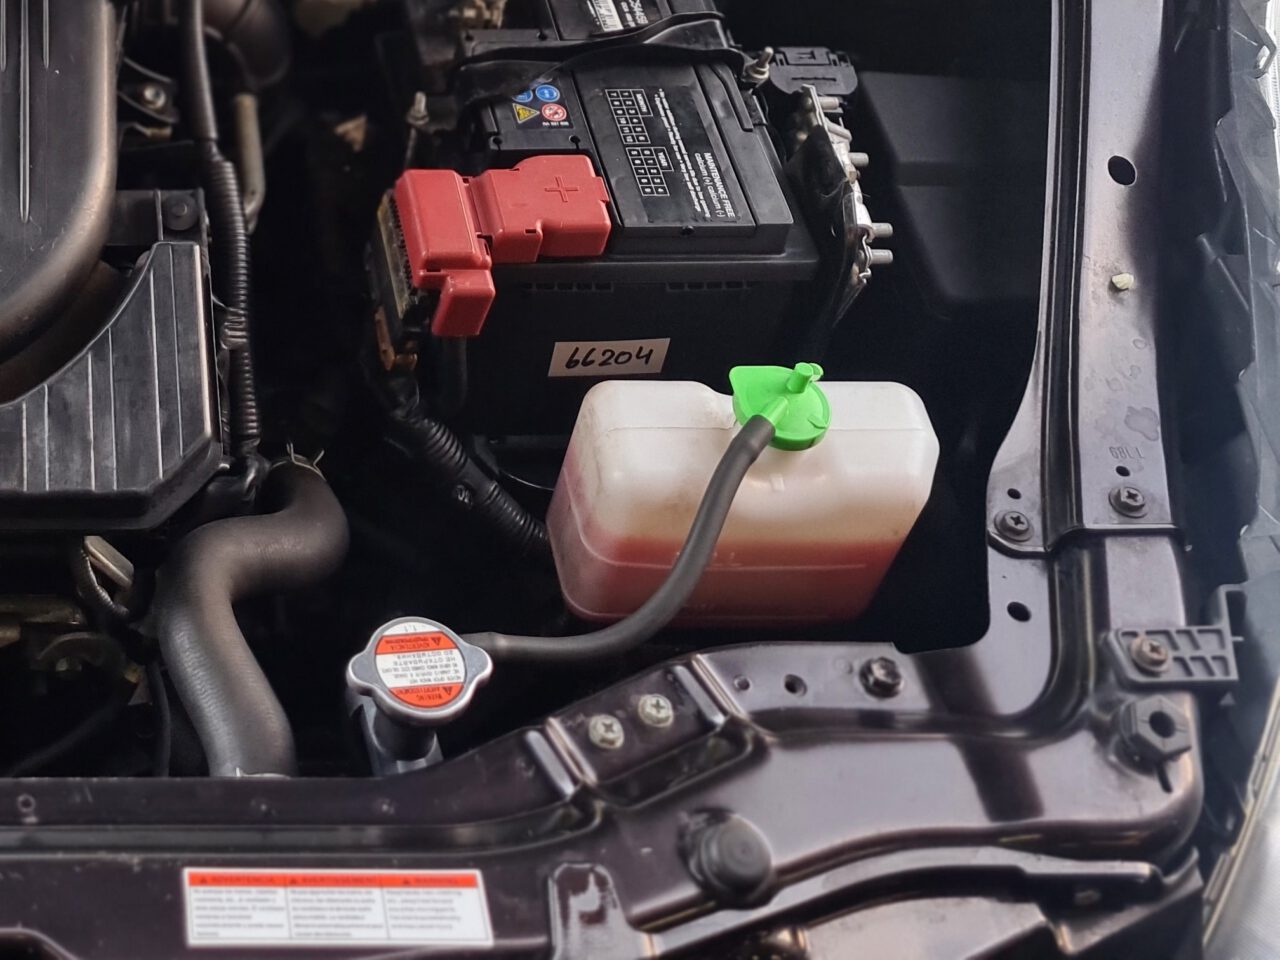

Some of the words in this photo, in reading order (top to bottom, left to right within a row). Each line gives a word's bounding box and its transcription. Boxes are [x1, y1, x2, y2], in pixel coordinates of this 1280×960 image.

[635, 93, 648, 112] MONTH
[657, 151, 668, 167] YEAR
[695, 153, 708, 176] calcium
[707, 186, 721, 209] calcium
[704, 153, 729, 200] MAINTENANCE
[722, 200, 736, 218] FREE
[565, 346, 654, 369] 66204
[1109, 446, 1135, 459] 68L
